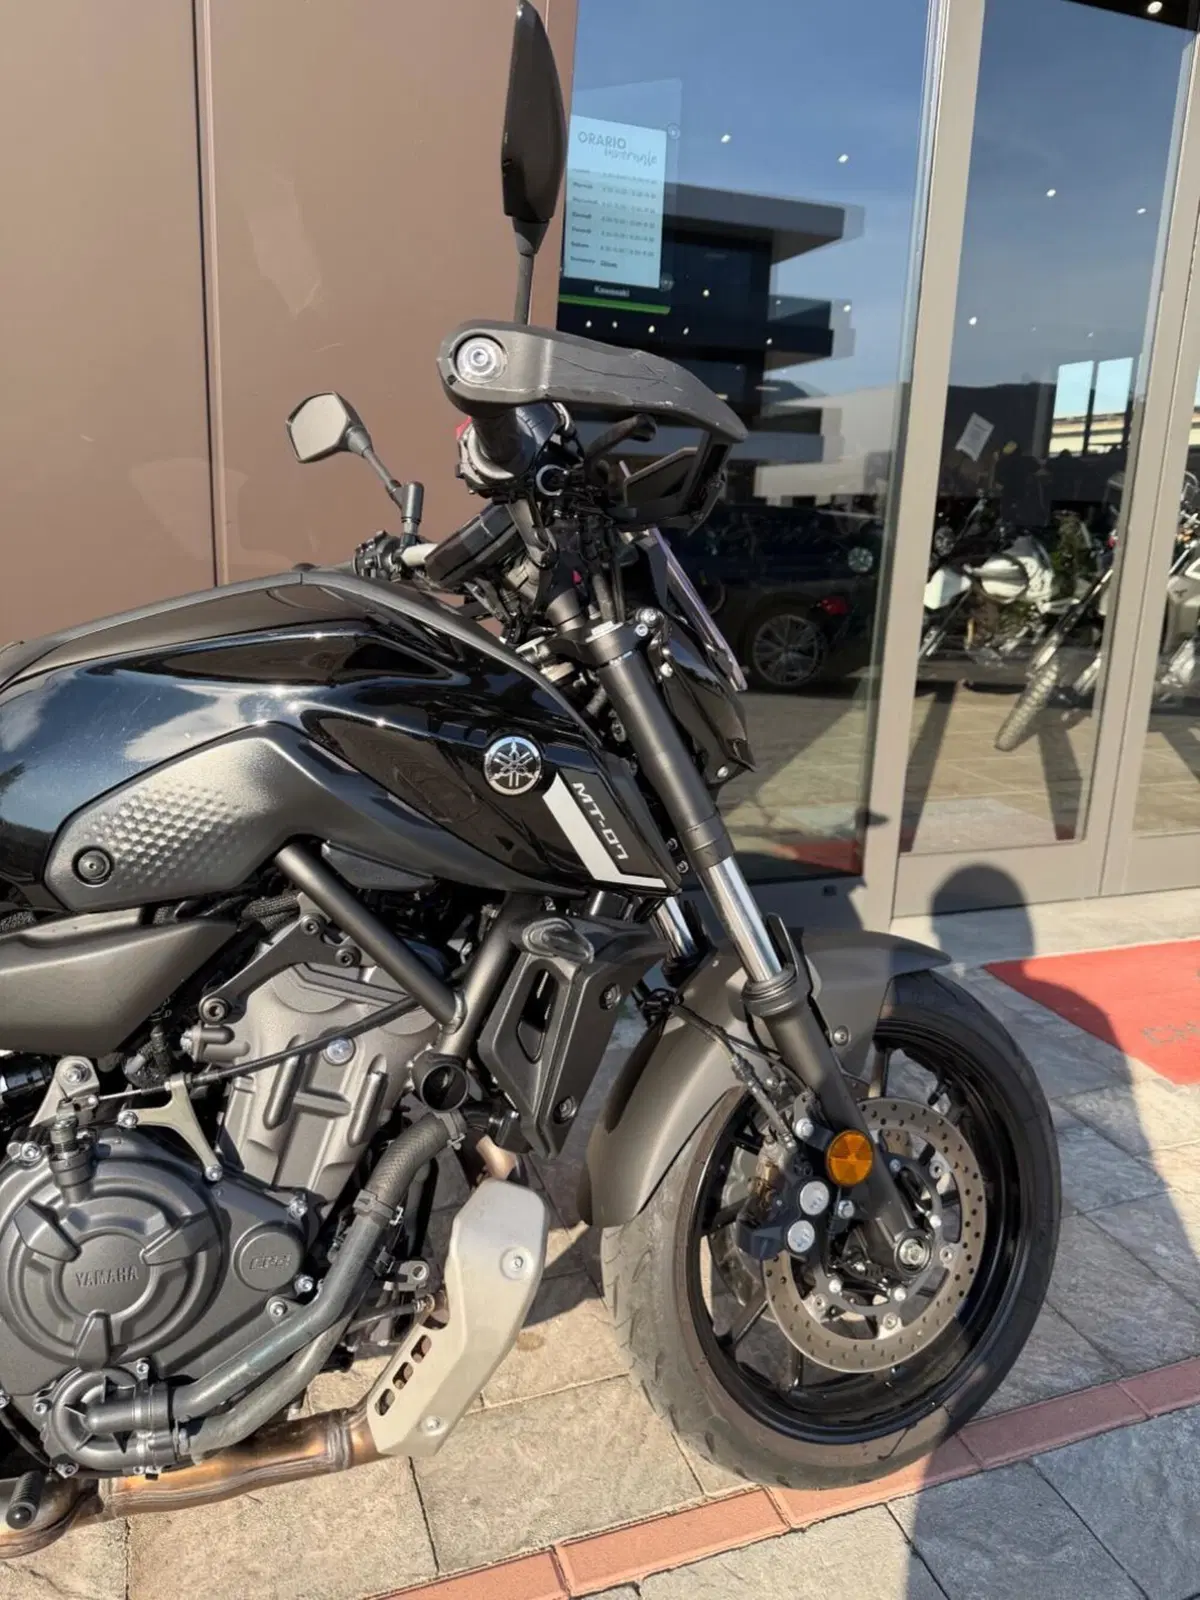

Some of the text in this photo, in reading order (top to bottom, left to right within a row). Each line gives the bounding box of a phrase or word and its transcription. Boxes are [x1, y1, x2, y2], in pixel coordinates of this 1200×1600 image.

[577, 131, 627, 149] ORARIO
[572, 782, 629, 859] MT-07
[75, 1264, 139, 1288] YAMAHA
